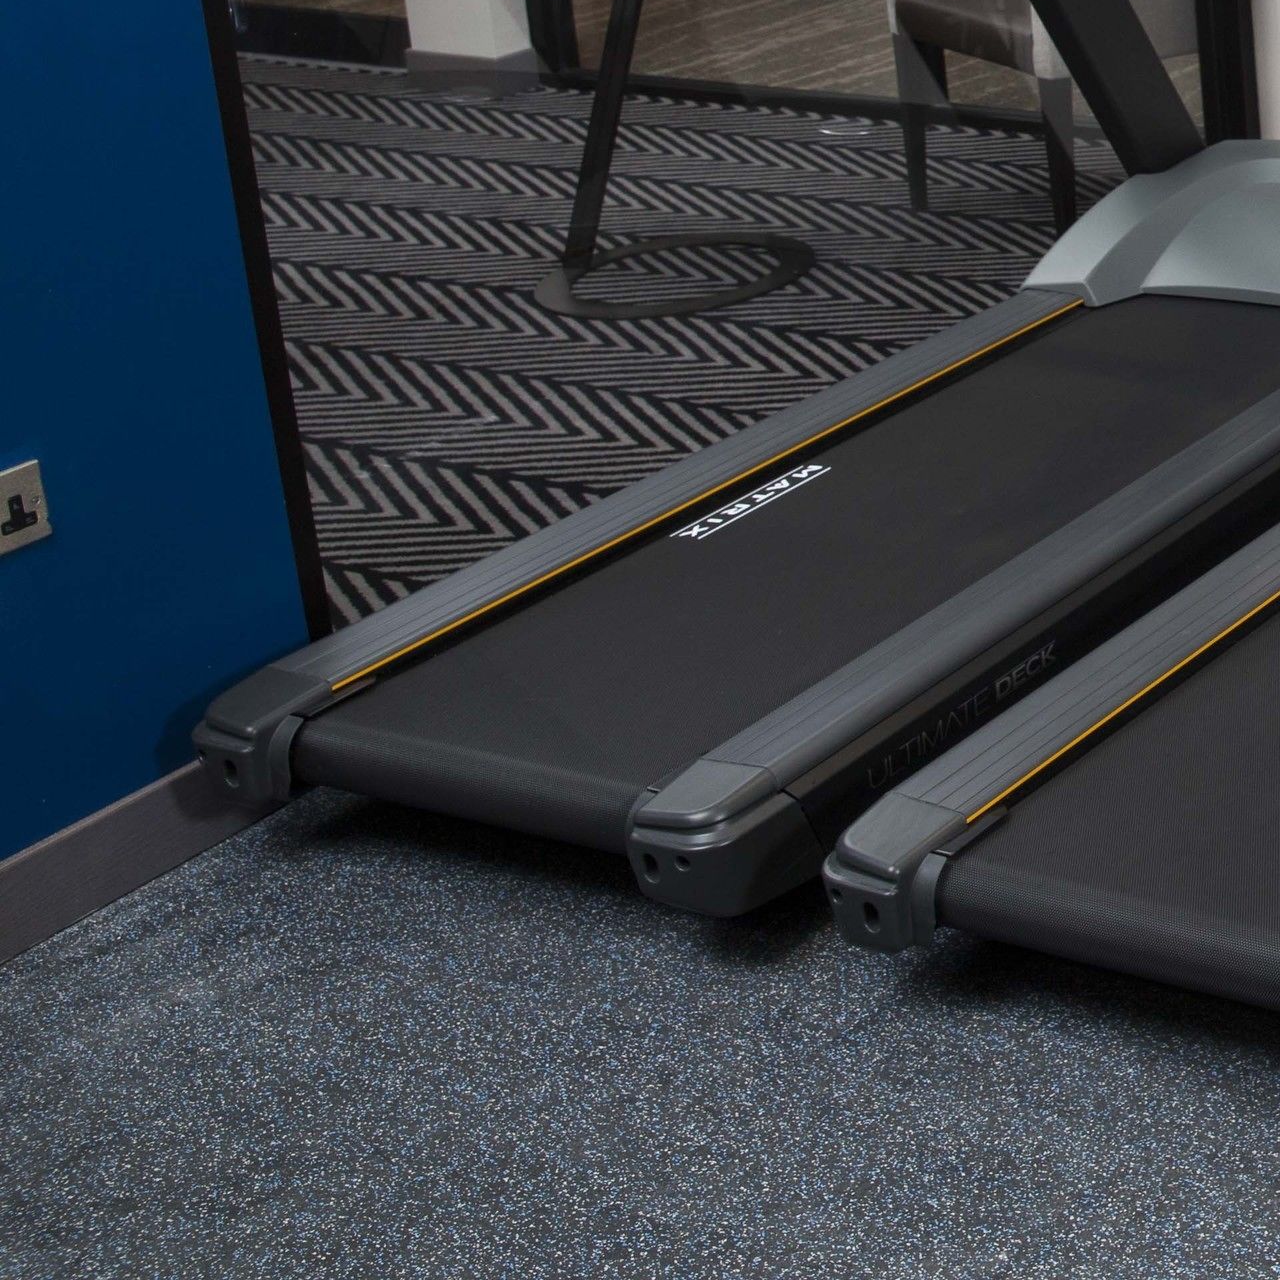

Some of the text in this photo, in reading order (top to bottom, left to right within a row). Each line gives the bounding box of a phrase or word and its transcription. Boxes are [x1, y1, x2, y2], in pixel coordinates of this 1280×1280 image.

[678, 464, 823, 538] MATRIX
[868, 639, 1057, 789] ULTIMATE DECK
